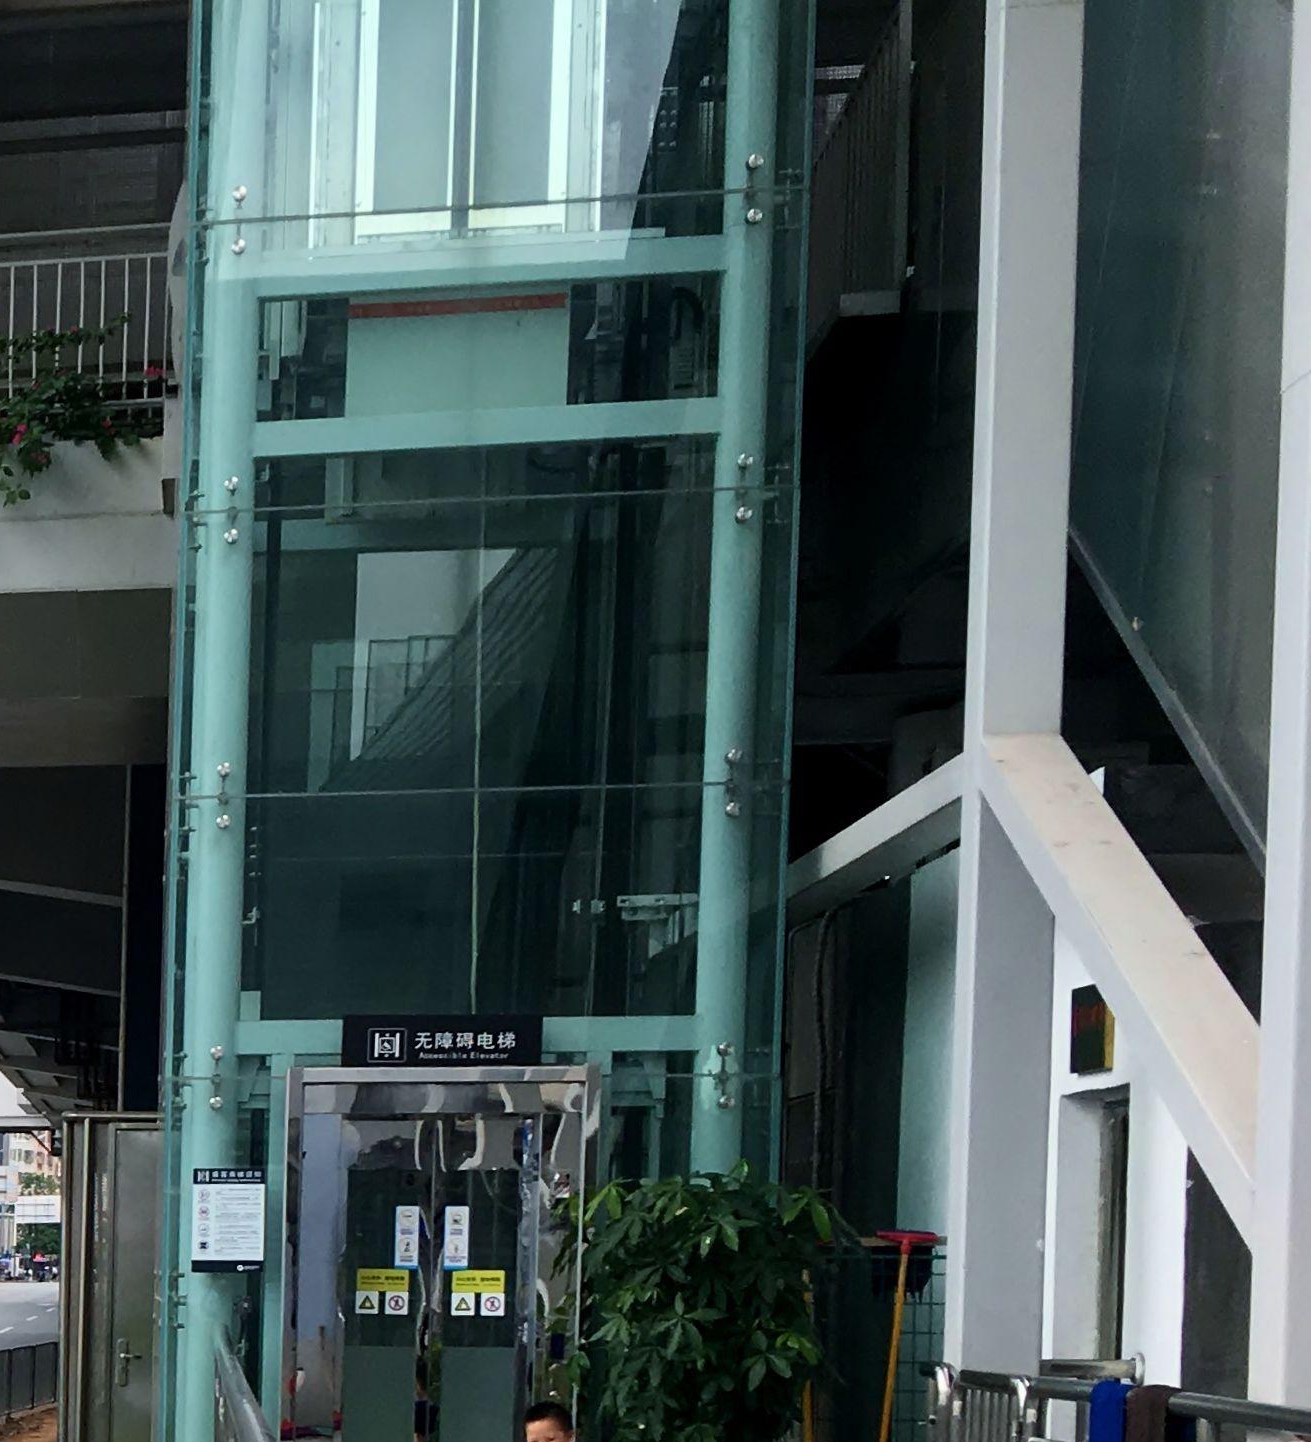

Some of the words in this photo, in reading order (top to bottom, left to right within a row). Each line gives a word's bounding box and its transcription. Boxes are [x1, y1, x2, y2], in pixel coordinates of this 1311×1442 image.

[415, 1031, 516, 1049] 无障碍电梯
